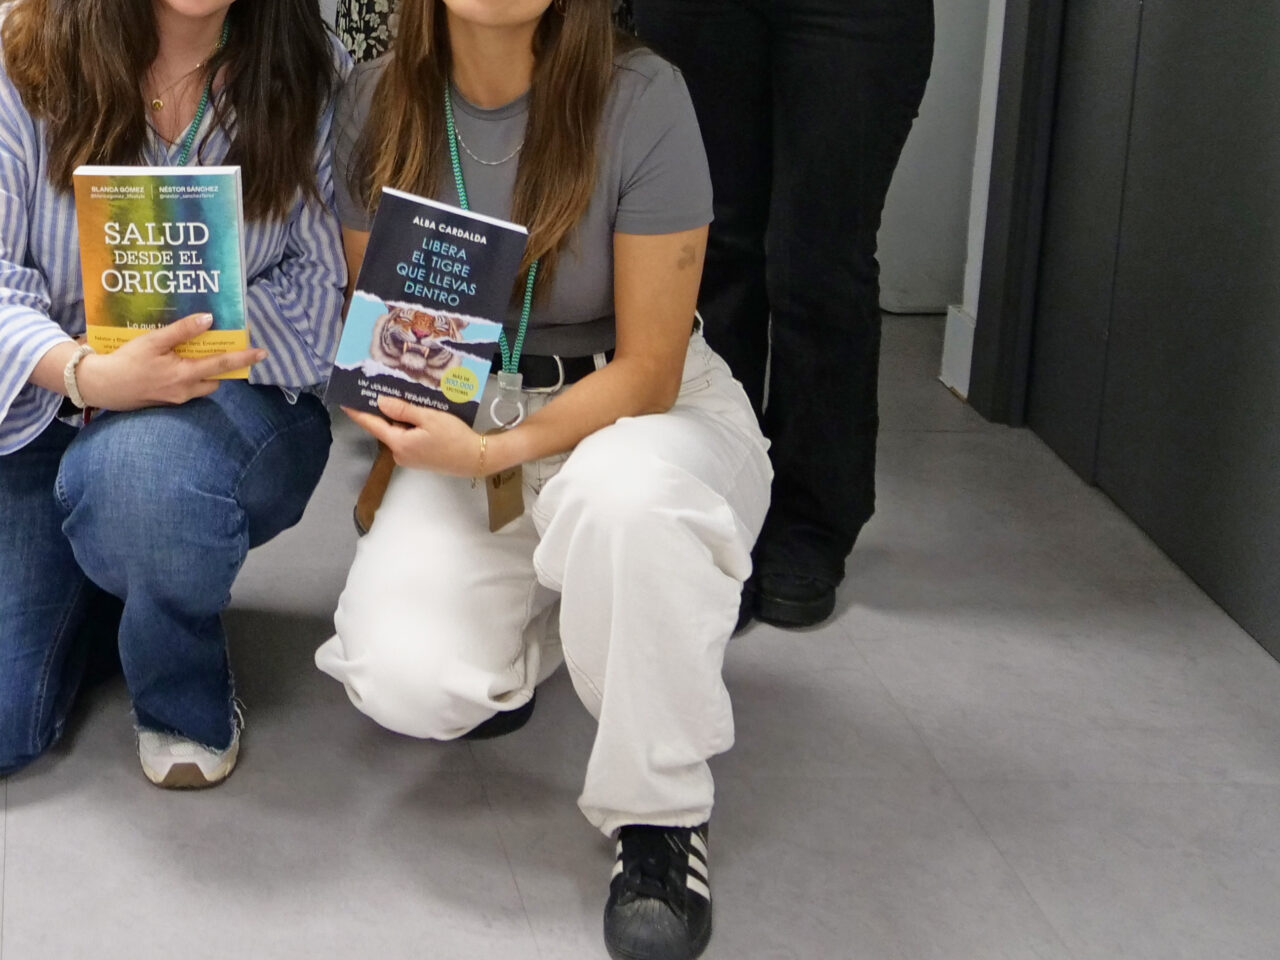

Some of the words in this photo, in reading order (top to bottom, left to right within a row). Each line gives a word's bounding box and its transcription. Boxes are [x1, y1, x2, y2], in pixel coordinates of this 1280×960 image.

[104, 222, 209, 246] SALUD
[413, 216, 436, 230] ALBA
[438, 223, 487, 245] CARDALDA
[114, 250, 173, 265] DESDE
[179, 251, 203, 265] EL
[422, 237, 467, 260] LIBERA
[412, 250, 425, 265] EL
[432, 256, 470, 278] TIGRE
[101, 269, 220, 294] ORIGEN
[396, 262, 426, 281] QUE
[429, 272, 477, 295] LLEVAS
[404, 280, 460, 306] DENTRO
